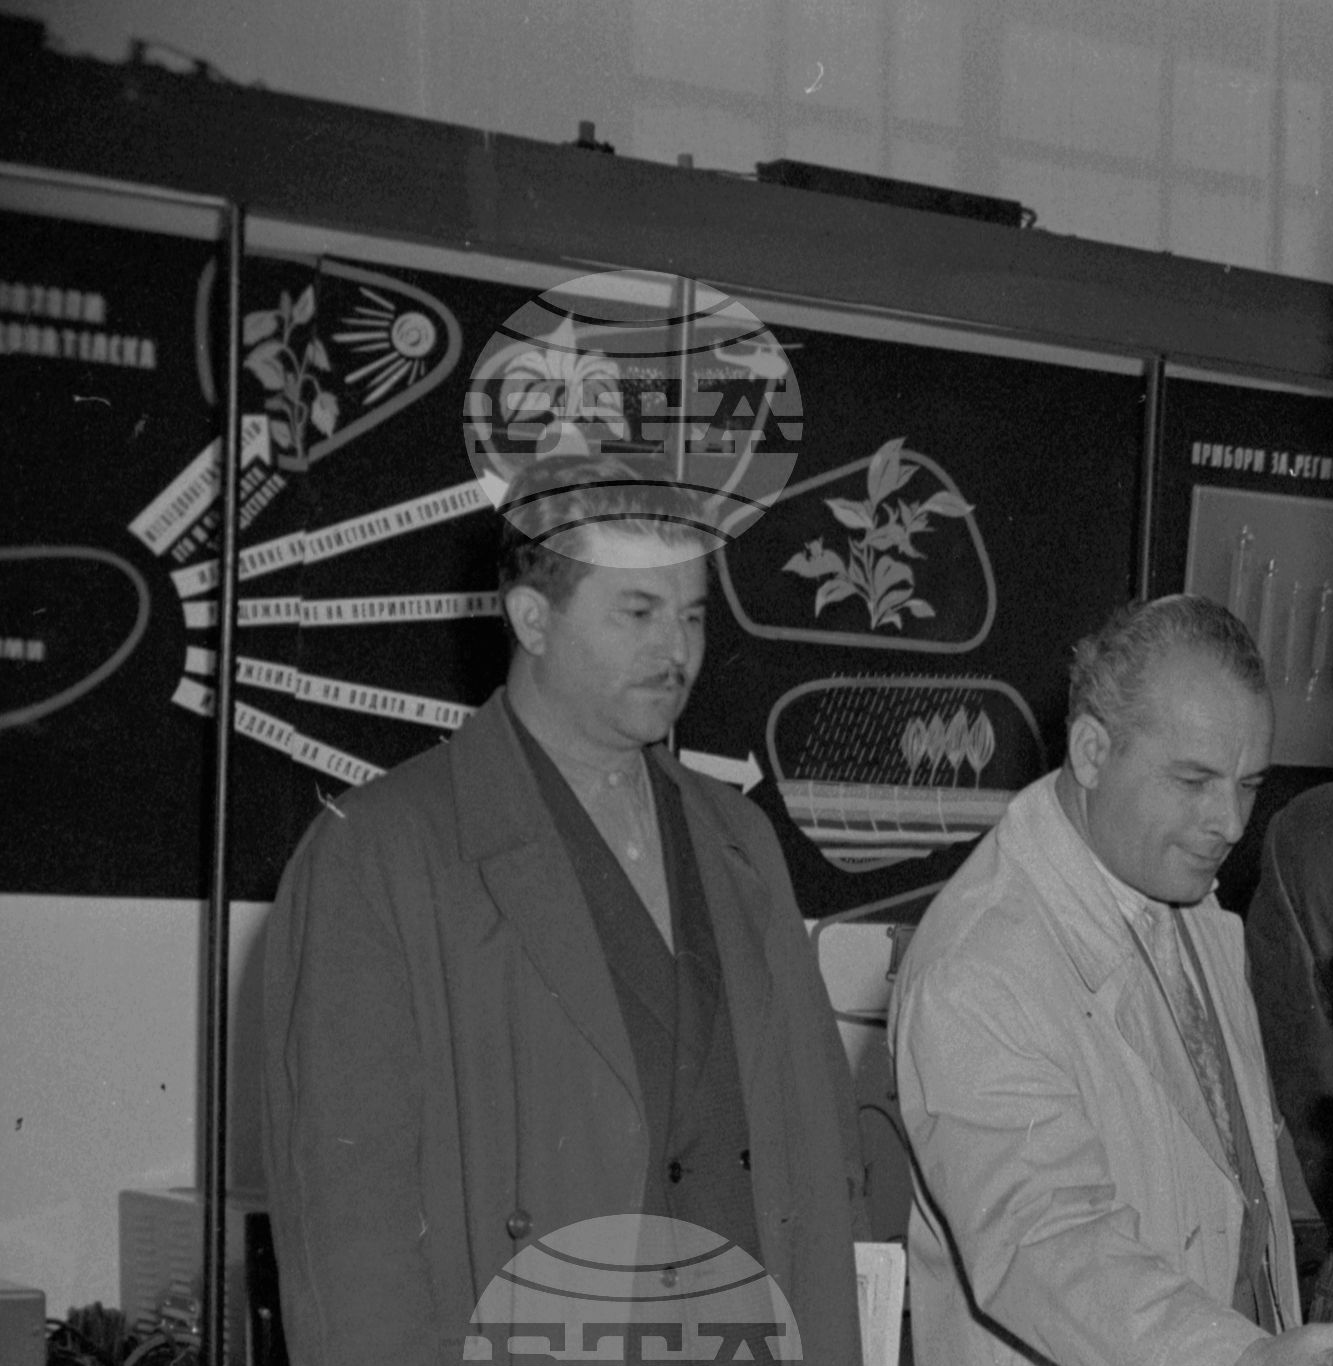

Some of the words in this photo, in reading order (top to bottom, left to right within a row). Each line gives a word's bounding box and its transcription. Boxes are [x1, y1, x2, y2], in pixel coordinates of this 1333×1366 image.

[1191, 441, 1266, 474] ПРИБОРИ
[1270, 451, 1289, 476] ЗА
[397, 510, 413, 529] НА
[418, 488, 480, 519] ТОРОВЕТЕ
[326, 602, 344, 619] НА
[352, 600, 458, 620] НЕПРИЯТЕЛИТЕ
[467, 597, 483, 612] НА
[322, 683, 340, 700] НА
[350, 688, 406, 714] ВОДАТА
[415, 703, 426, 718] И
[300, 737, 318, 761] НА
